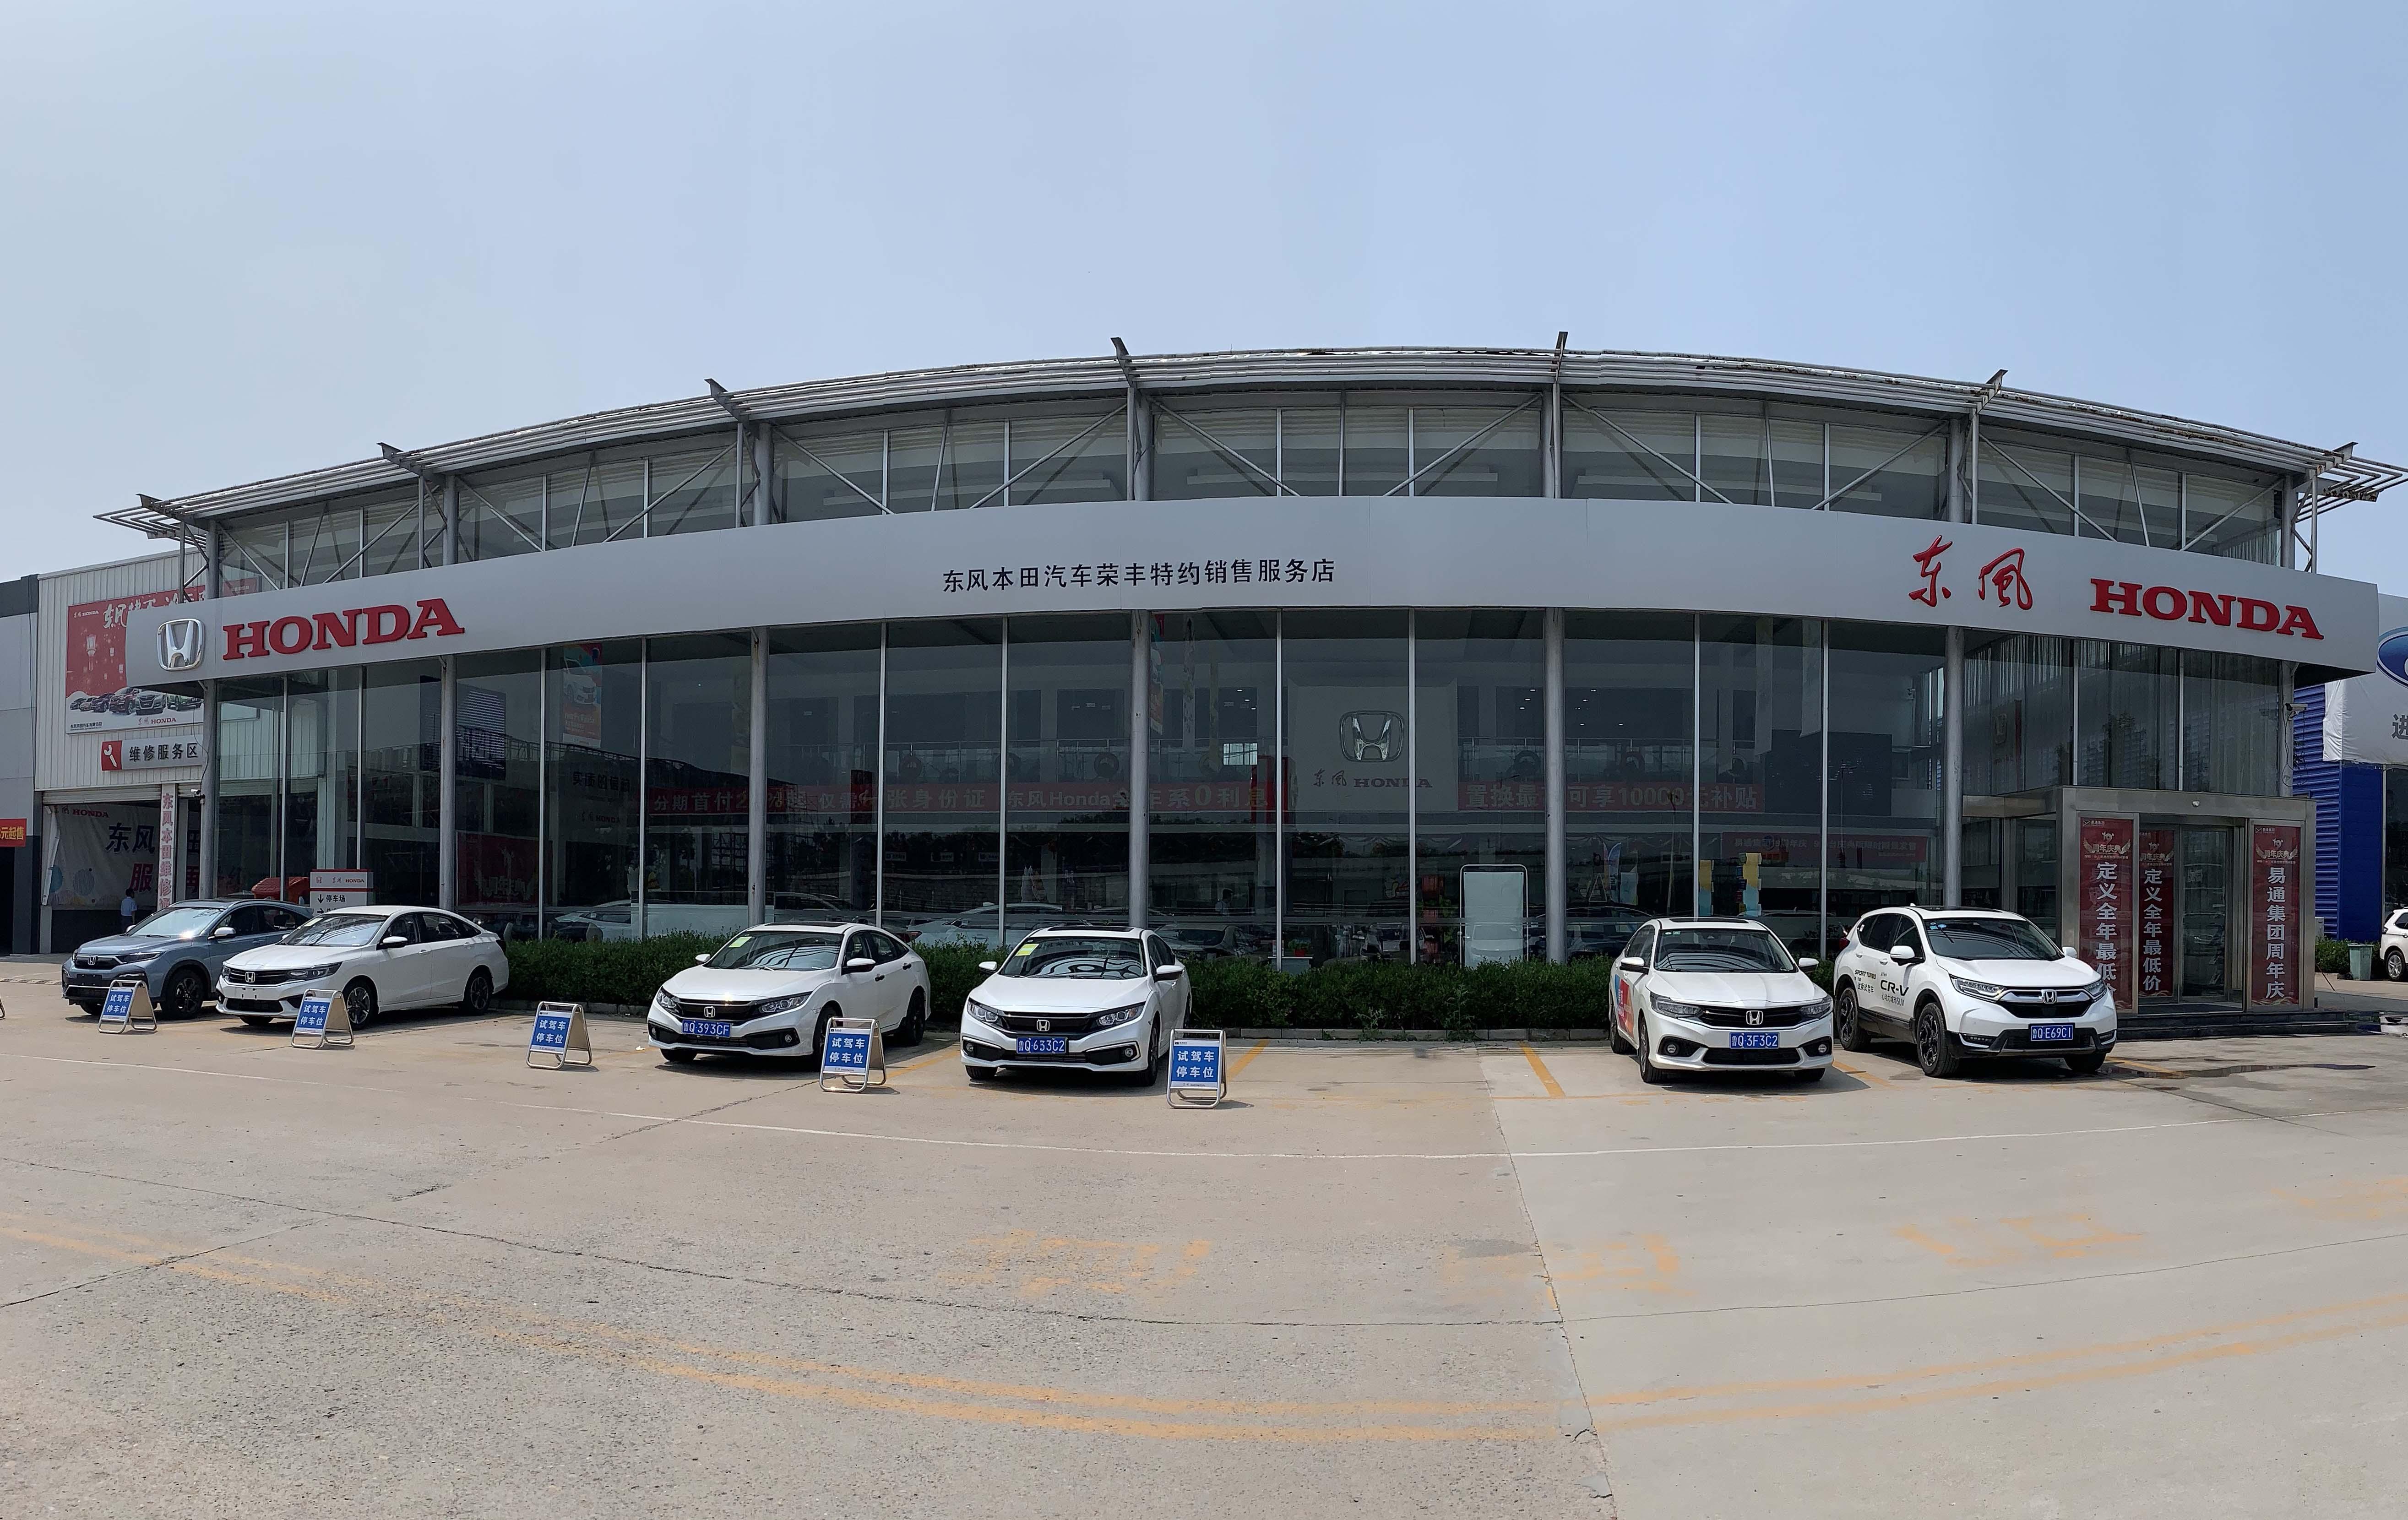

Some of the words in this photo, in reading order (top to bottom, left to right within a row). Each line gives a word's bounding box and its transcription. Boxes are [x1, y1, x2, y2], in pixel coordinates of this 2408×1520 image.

[943, 559, 1335, 593] 东风本田汽车荣丰特约销售服务店
[2090, 578, 2324, 640] HONDA
[223, 598, 465, 660] HONDA
[129, 742, 198, 762] 维修服务区
[72, 809, 109, 818] HONDA
[0, 826, 24, 840] 元起售
[2142, 869, 2163, 991] 定义全年最低价
[2266, 867, 2286, 999] 易通集团周年庆
[1880, 980, 1909, 996] CR-V
[304, 1005, 326, 1014] 试驾车
[300, 1016, 323, 1026] 停车位
[539, 1020, 566, 1031] 试驾车
[536, 1032, 563, 1043] 停车位
[832, 1037, 864, 1049] 试驾车
[829, 1052, 863, 1064] 停车位
[1177, 1050, 1214, 1062] 试驾车
[1176, 1066, 1214, 1078] 停车位
